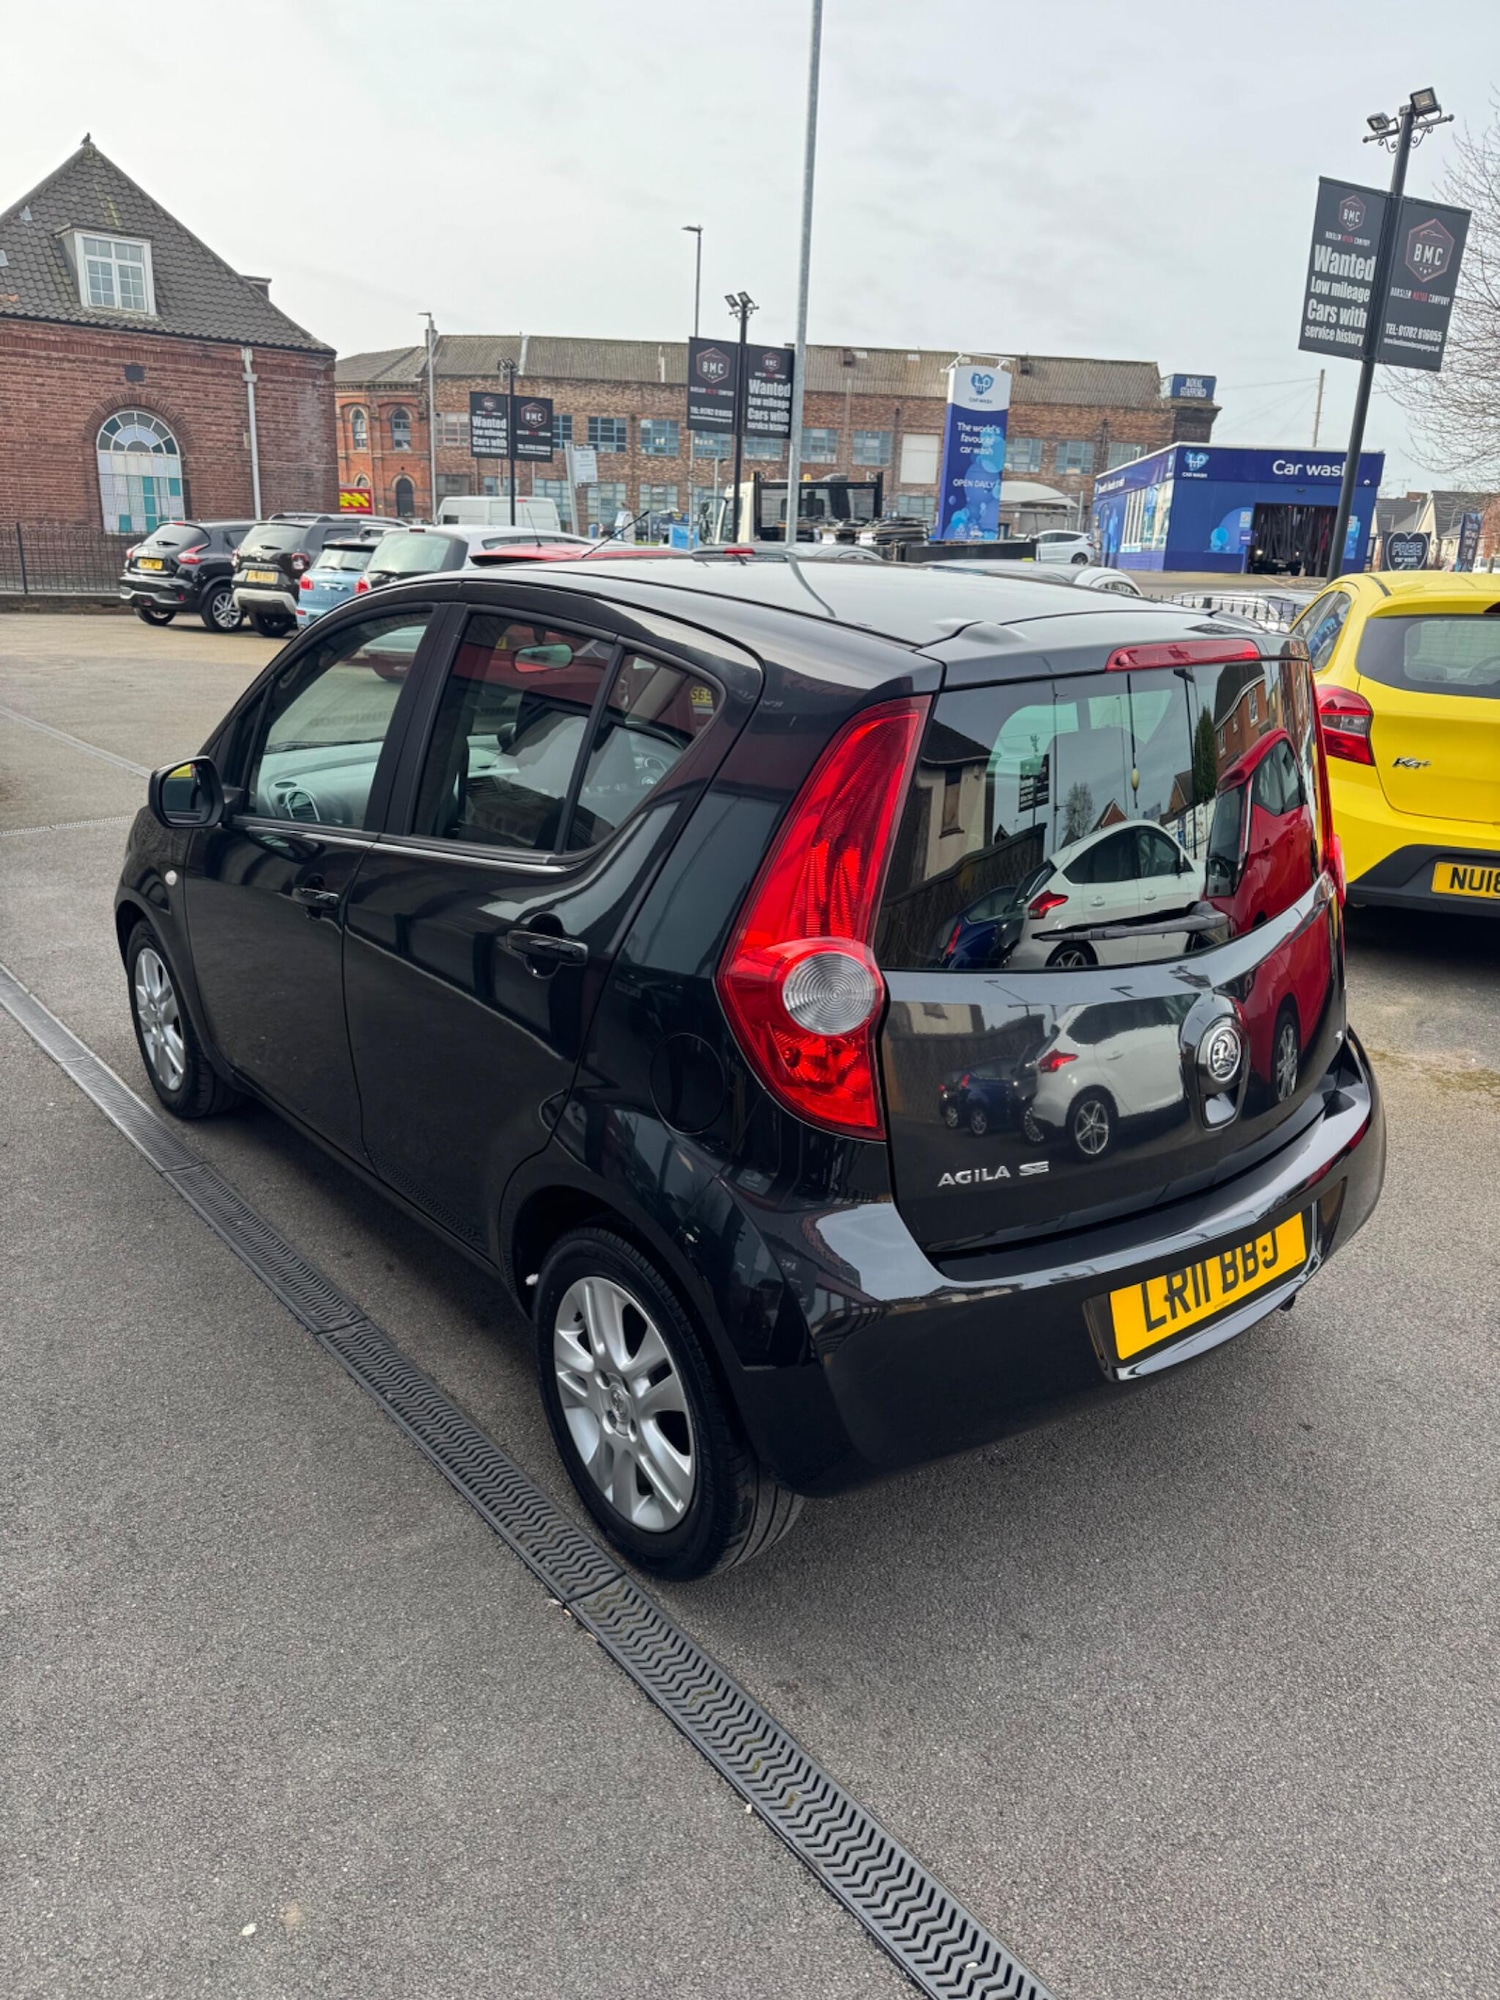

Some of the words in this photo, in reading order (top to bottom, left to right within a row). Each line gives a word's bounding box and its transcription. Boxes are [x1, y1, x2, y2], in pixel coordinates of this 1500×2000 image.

[1413, 243, 1444, 266] BMC
[1314, 244, 1377, 282] Wanted
[1310, 276, 1331, 295] Low
[1331, 281, 1371, 304] mileage
[1307, 298, 1338, 323] Cars
[1339, 306, 1368, 329] with
[1304, 325, 1336, 341] service
[1336, 328, 1365, 347] history
[702, 361, 724, 374] BMC
[749, 379, 791, 397] Wanted
[748, 396, 761, 406] Low
[762, 397, 790, 409] mileage
[525, 412, 542, 421] BMC
[748, 408, 769, 421] Cars
[770, 411, 789, 422] with
[472, 416, 507, 429] Wanted
[747, 422, 769, 430] service
[769, 423, 789, 433] history
[957, 421, 971, 432] The
[473, 436, 489, 446] Cars
[960, 446, 972, 454] car
[973, 447, 994, 455] wash
[1272, 460, 1303, 475] Car
[953, 478, 973, 488] OPEN
[975, 480, 995, 489] DAILY
[1392, 542, 1423, 555] FREE
[937, 1165, 1011, 1187] AGILA
[1019, 1161, 1049, 1176] SE
[1141, 1259, 1211, 1333] LR11
[1219, 1229, 1279, 1295] BBJ
